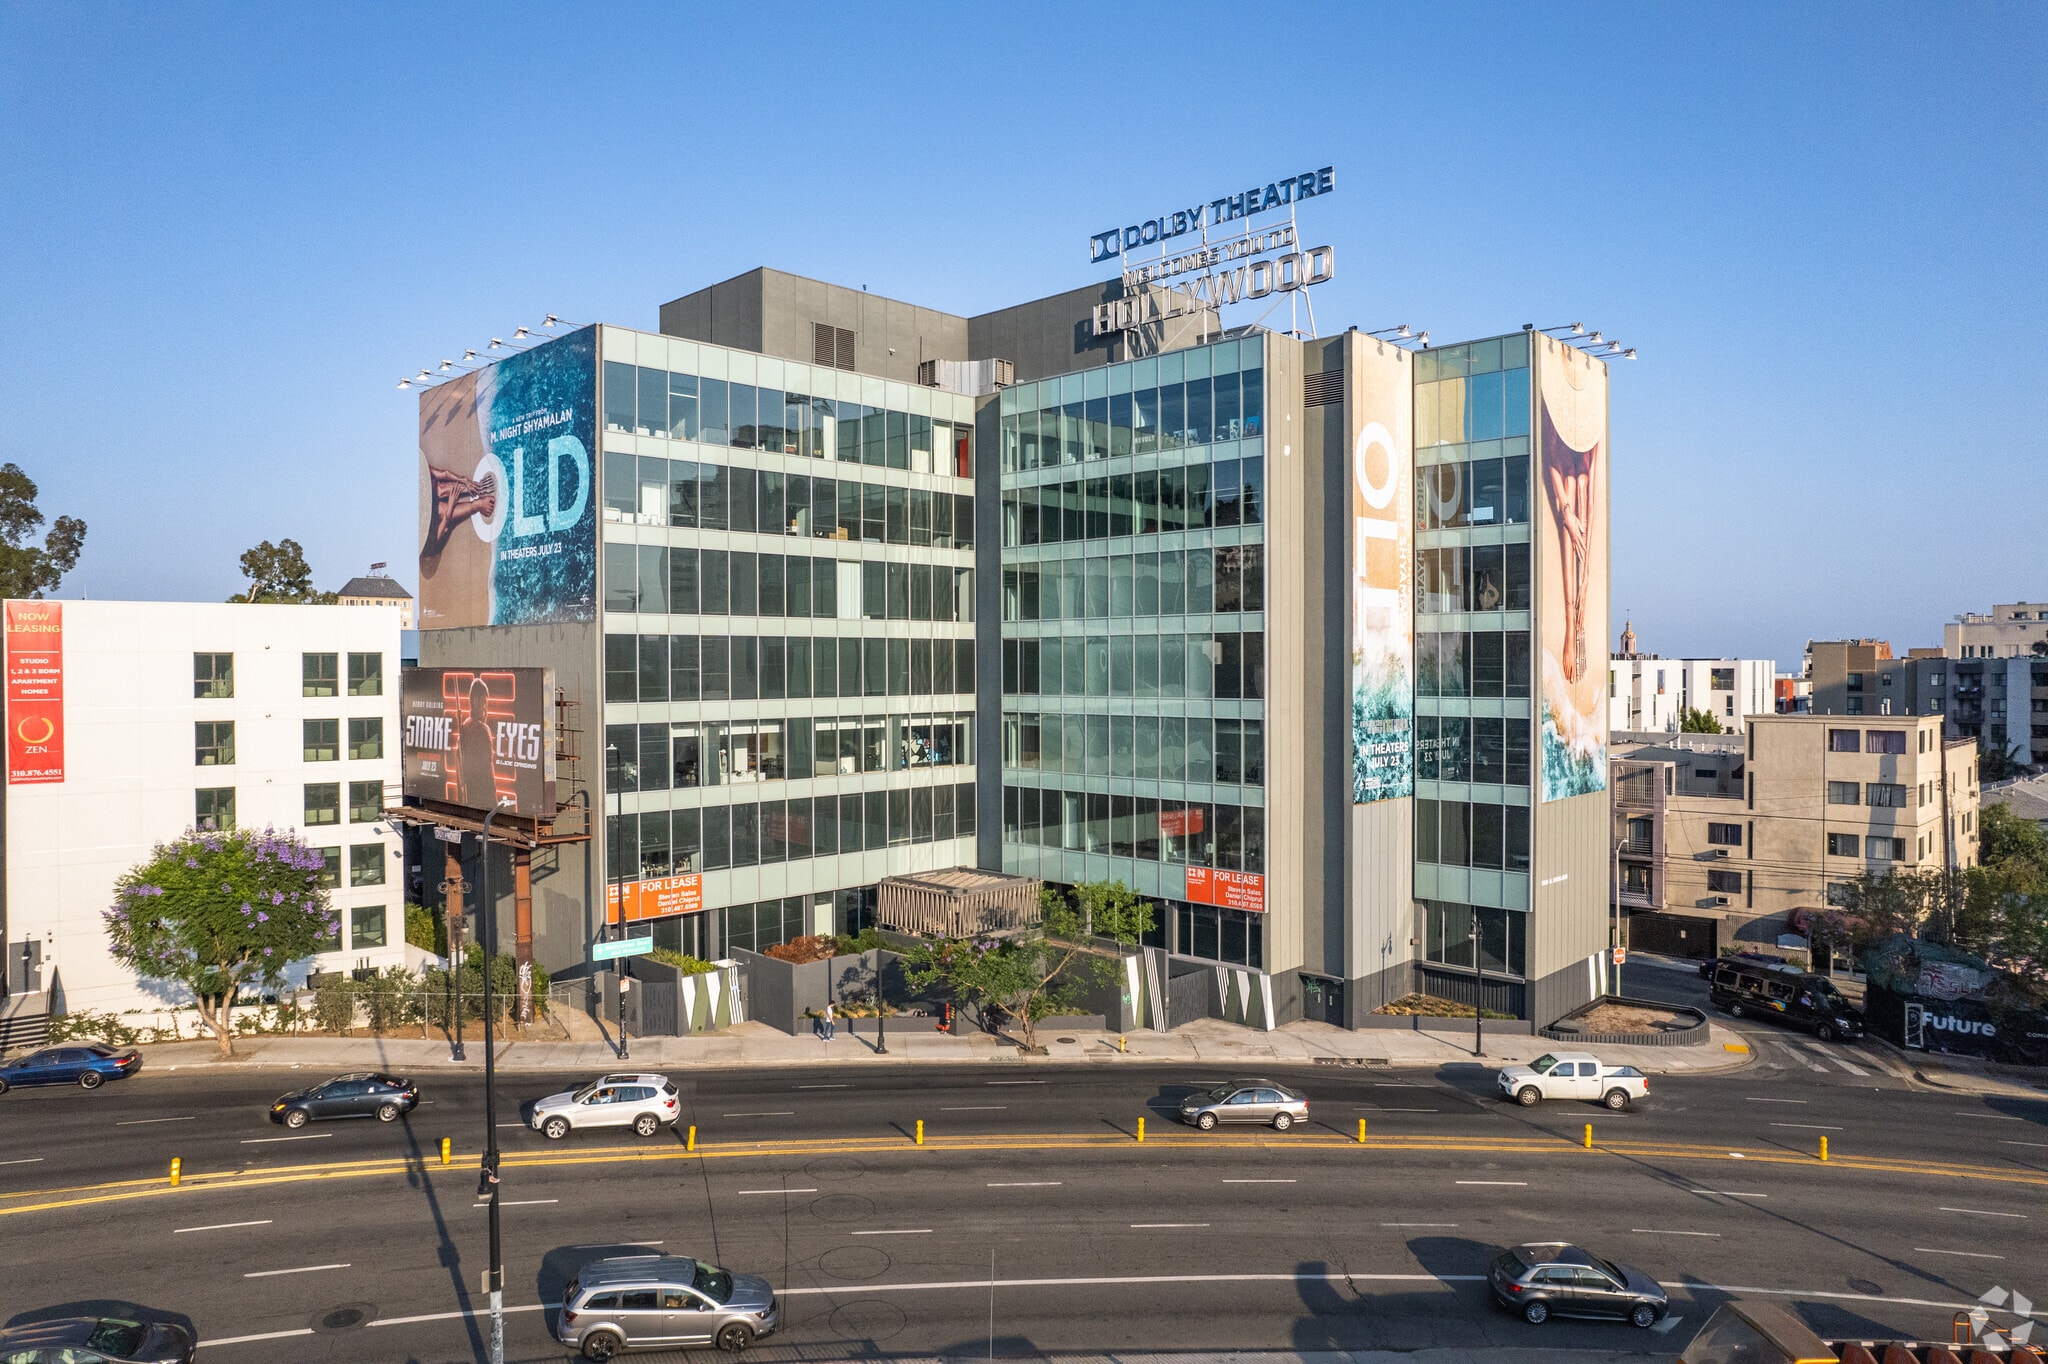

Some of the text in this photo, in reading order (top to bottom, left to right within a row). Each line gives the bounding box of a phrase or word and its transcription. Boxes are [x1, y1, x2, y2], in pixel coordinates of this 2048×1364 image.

[1124, 165, 1335, 251] DOLBY THEATRE
[1122, 226, 1297, 288] WELCOMES YOU TO
[1092, 245, 1334, 336] HOLLYWOOD
[490, 408, 573, 444] M. NIGHT SHYAMALAN
[470, 434, 590, 543] OLD
[1399, 474, 1407, 529] NIGHT
[501, 542, 562, 561] IN THEATERS JULY 23
[18, 612, 49, 621] NOW
[7, 624, 60, 633] LEASING
[406, 715, 453, 751] SNAKE
[496, 721, 541, 761] EYES
[25, 745, 48, 754] ZEN
[1360, 741, 1409, 757] IN THEATERS
[1371, 755, 1400, 768] JULY 23
[11, 768, 62, 777] 310.876.4551
[641, 876, 698, 893] FOR LEASE
[1214, 871, 1230, 882] FOR
[1232, 873, 1259, 886] LEASE
[658, 891, 679, 900] Steven
[1225, 891, 1263, 903] Daniel Chiprut
[1227, 885, 1261, 896] Steven Salas
[657, 895, 700, 907] Daniel Chiprut
[1922, 1012, 1996, 1037] Future
